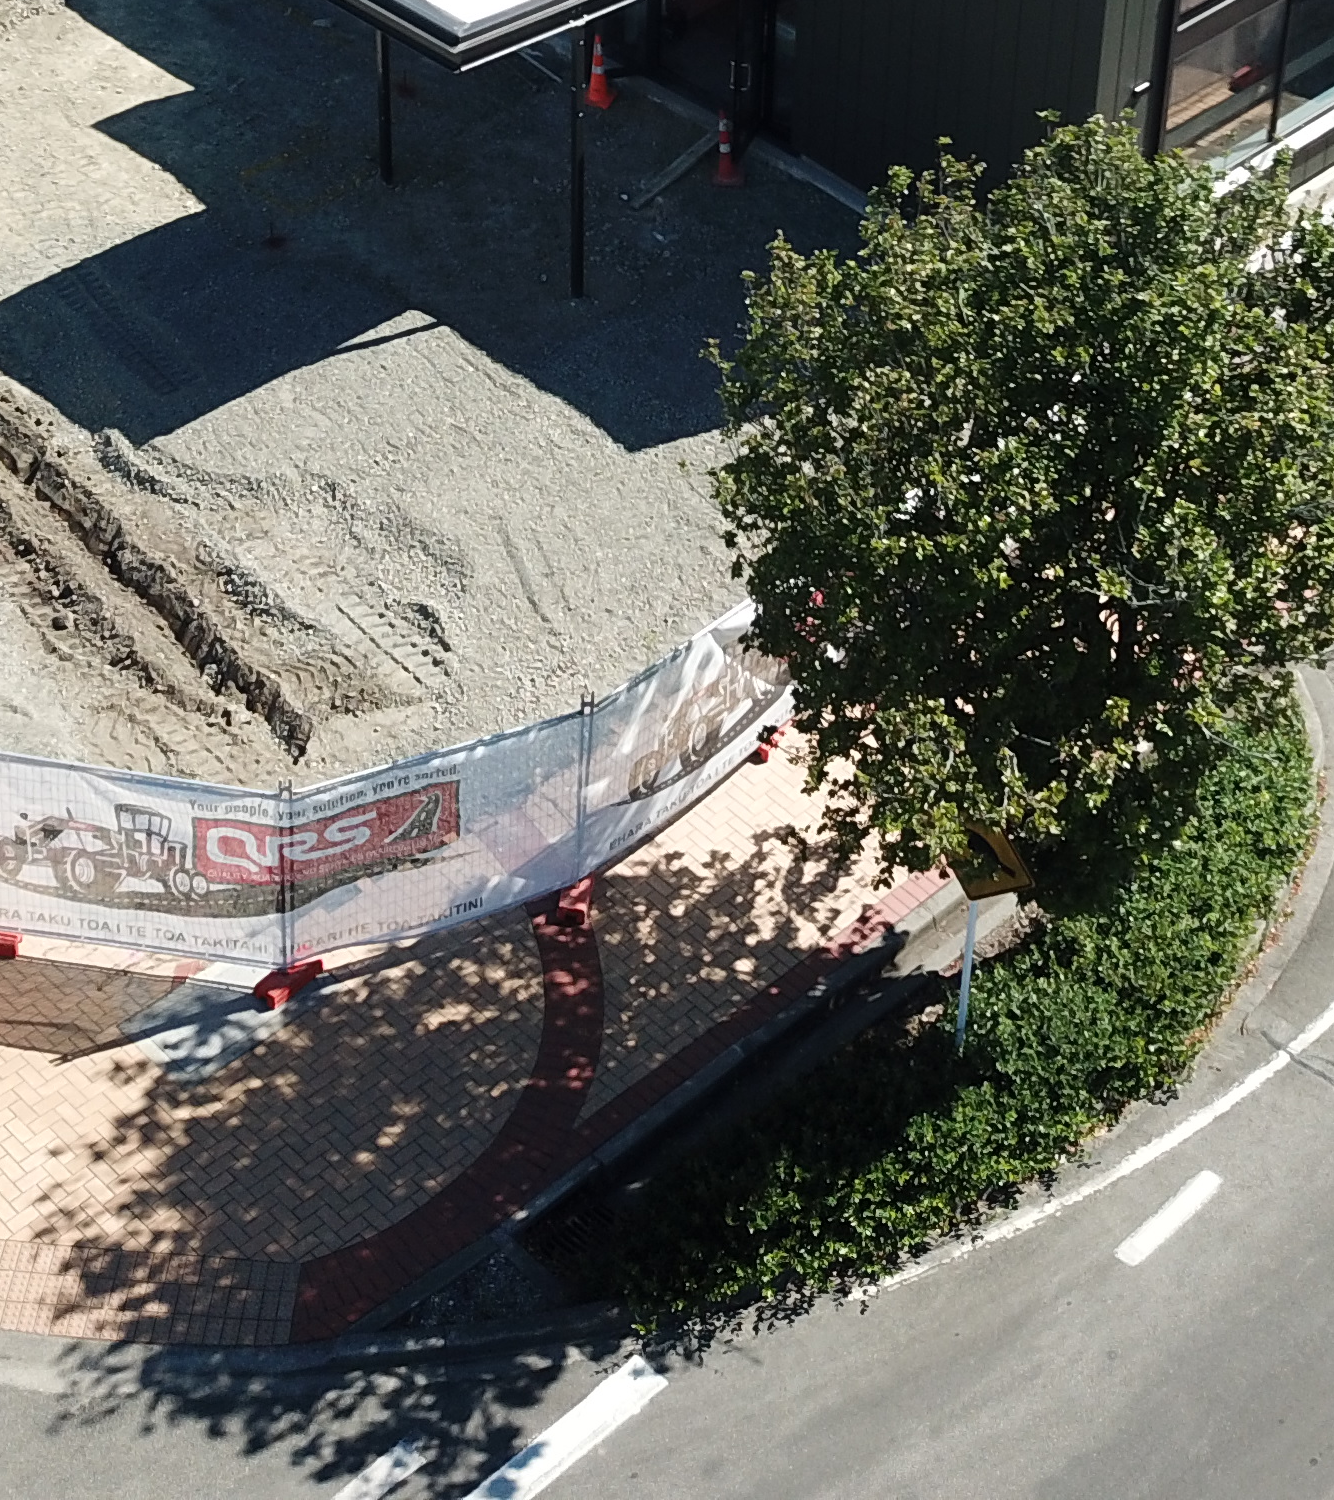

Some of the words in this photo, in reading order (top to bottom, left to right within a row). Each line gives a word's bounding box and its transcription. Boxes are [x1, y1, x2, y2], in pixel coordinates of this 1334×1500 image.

[189, 800, 219, 813] Your
[206, 810, 377, 873] QRS
[26, 911, 71, 928] TAKU
[79, 917, 111, 933] TOA
[126, 924, 147, 938] TE
[152, 927, 187, 944] TOA
[348, 922, 369, 936] HE
[377, 919, 411, 934] TOA
[416, 897, 483, 927] TAKITINI
